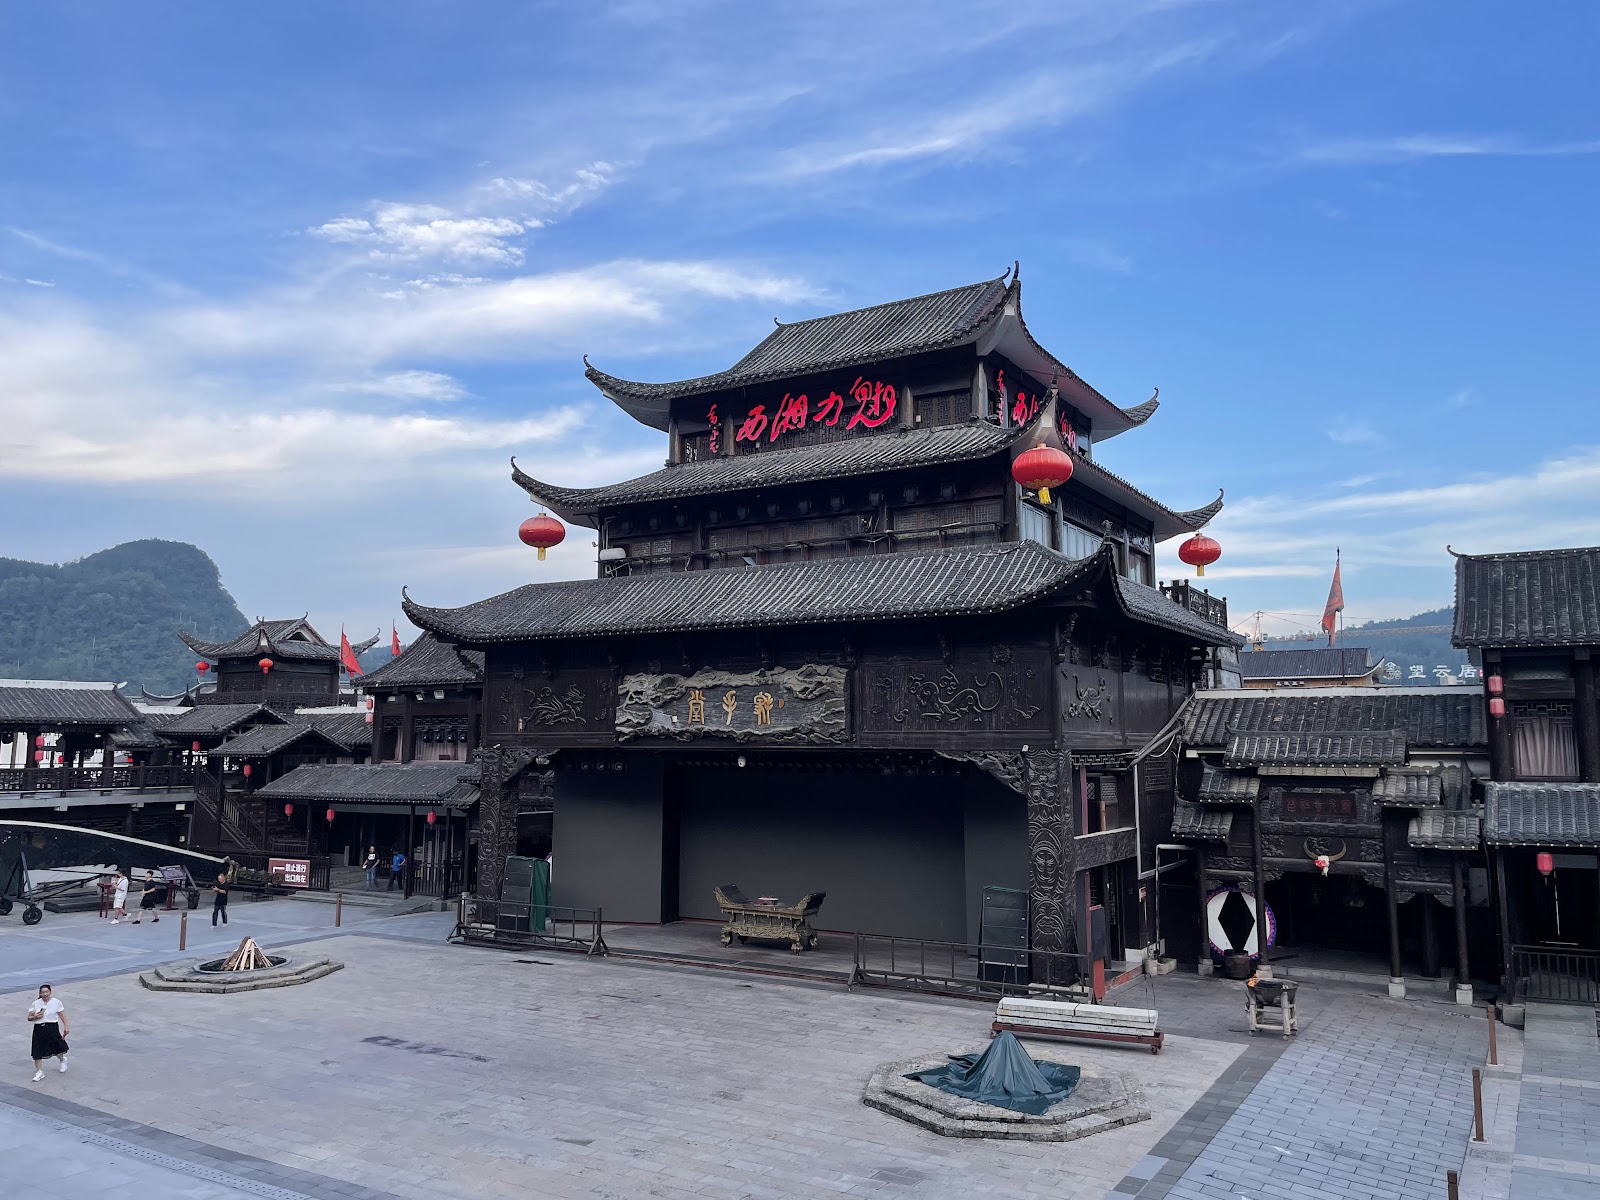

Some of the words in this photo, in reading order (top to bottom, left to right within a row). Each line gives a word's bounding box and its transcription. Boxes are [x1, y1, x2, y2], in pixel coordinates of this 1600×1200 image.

[1408, 664, 1477, 679] 望云居
[284, 873, 306, 882] 出口向左
